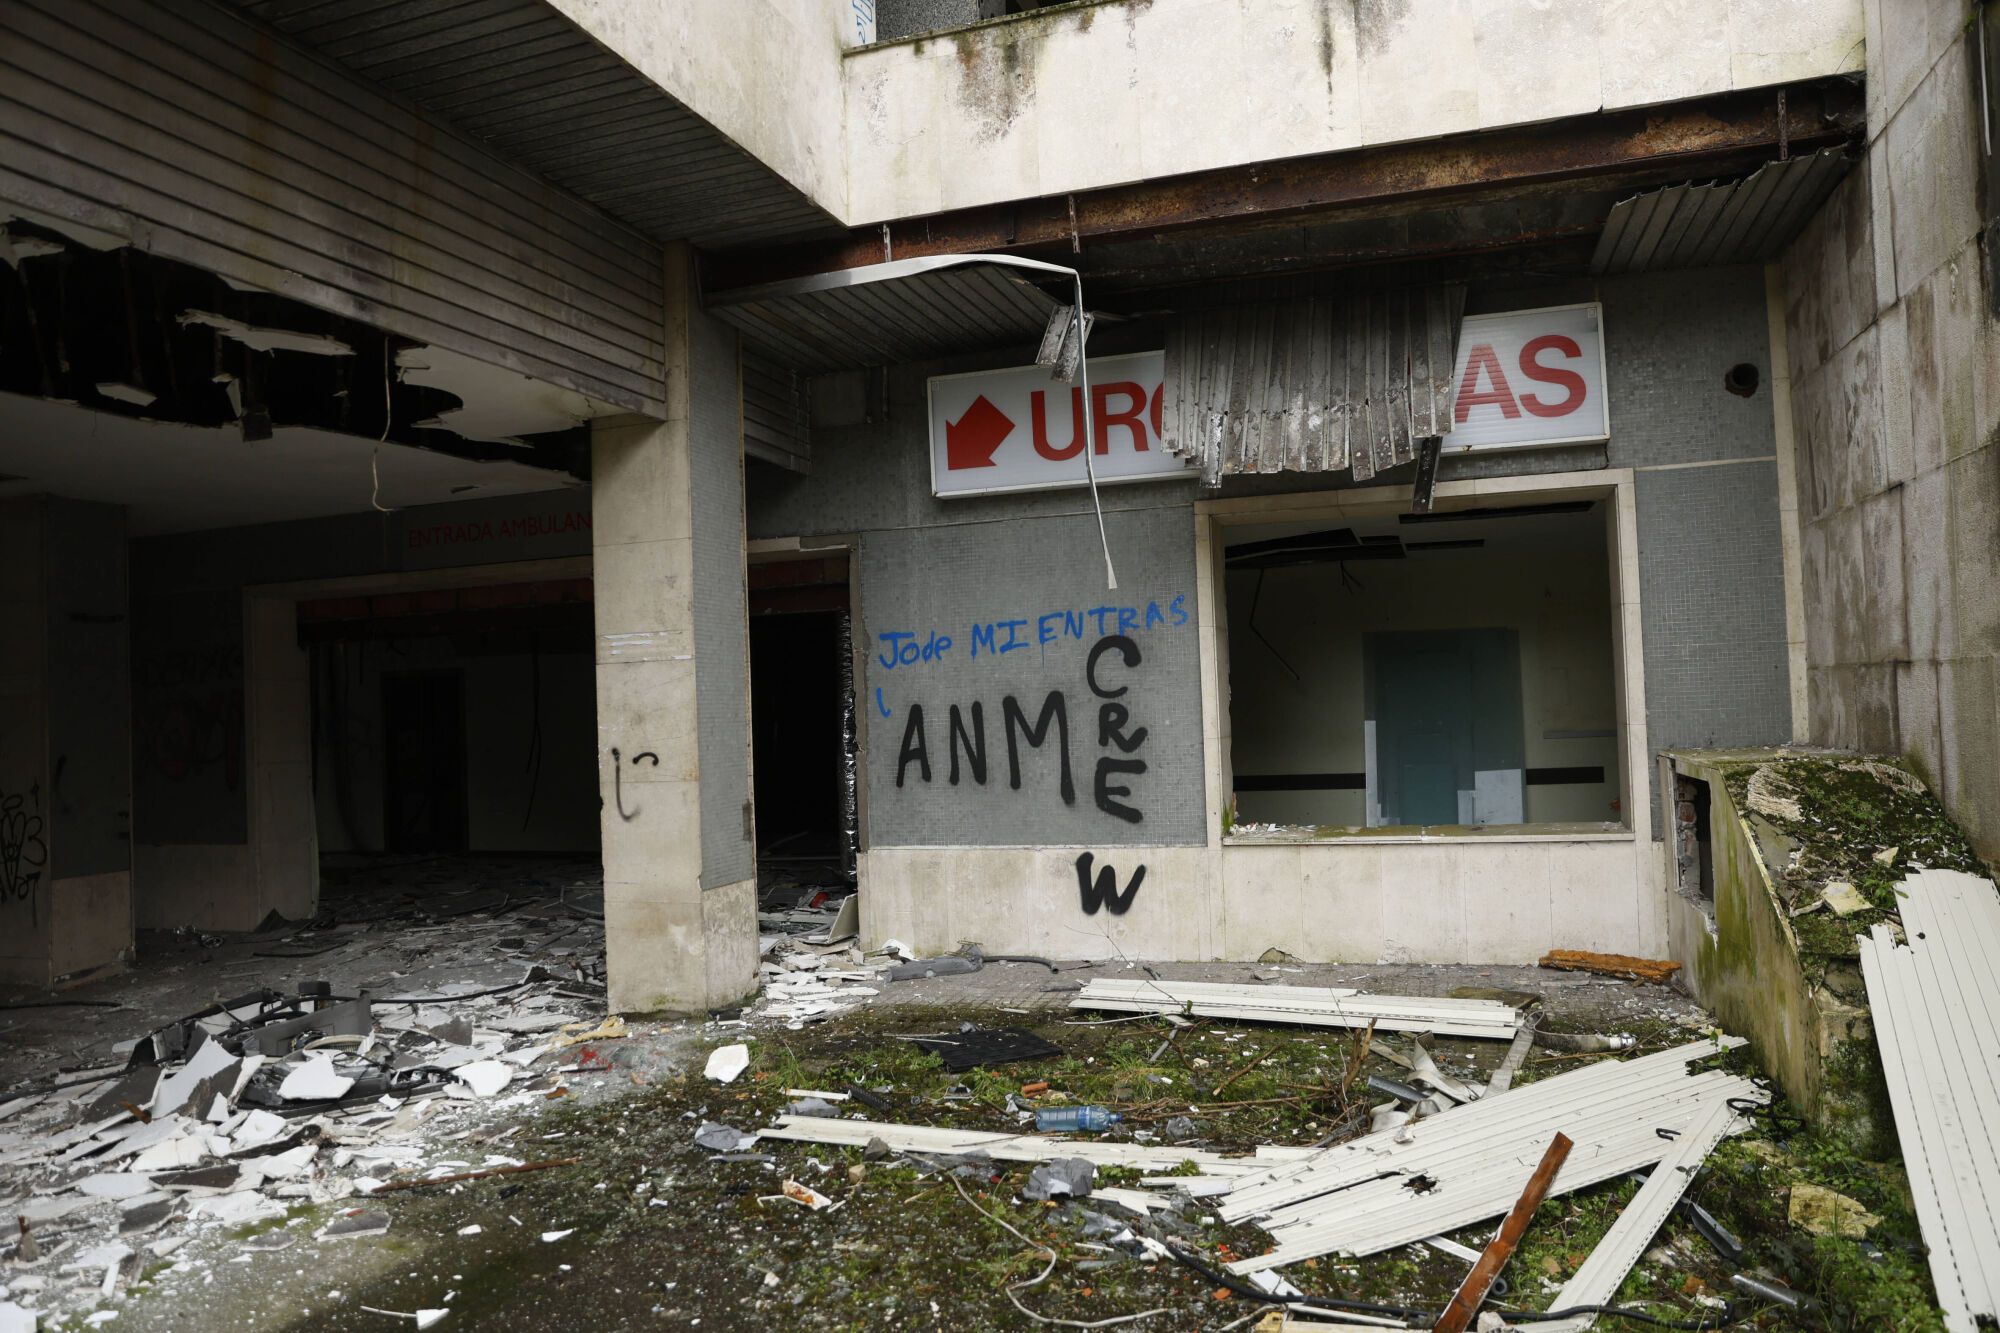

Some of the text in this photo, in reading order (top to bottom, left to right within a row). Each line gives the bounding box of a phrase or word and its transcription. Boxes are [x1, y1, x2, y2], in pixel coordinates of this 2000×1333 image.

[408, 511, 592, 549] ENTRADA AMBULAN
[970, 595, 1189, 661] MIENTRAS
